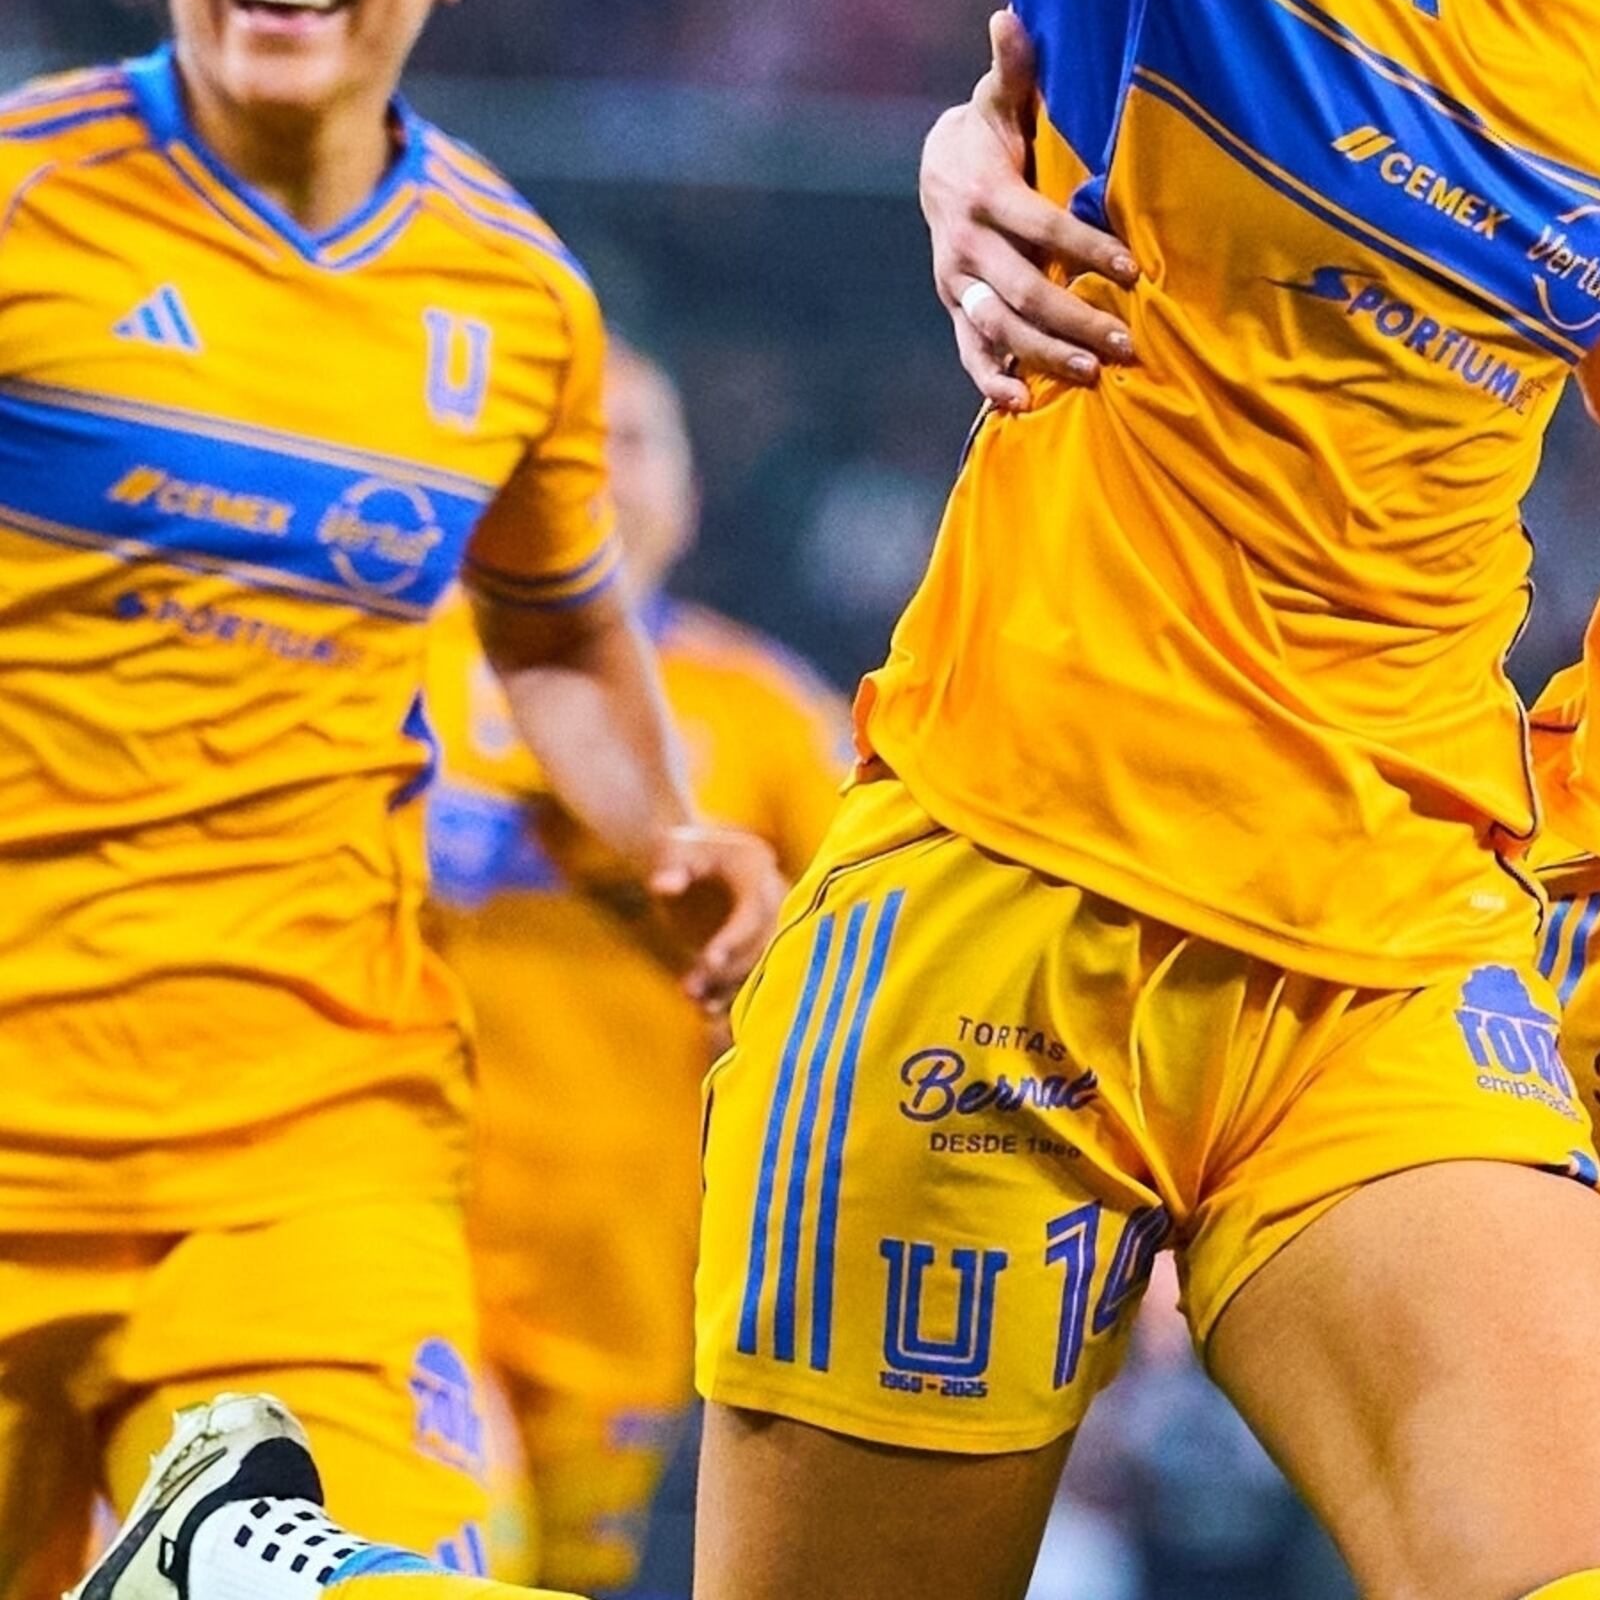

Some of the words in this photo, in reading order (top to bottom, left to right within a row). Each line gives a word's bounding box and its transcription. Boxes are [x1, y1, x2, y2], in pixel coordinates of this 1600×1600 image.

[1380, 152, 1511, 240] CEMEX
[958, 1016, 1069, 1062] TORTAS
[929, 1131, 1017, 1155] DESDE
[879, 1237, 1009, 1378] U
